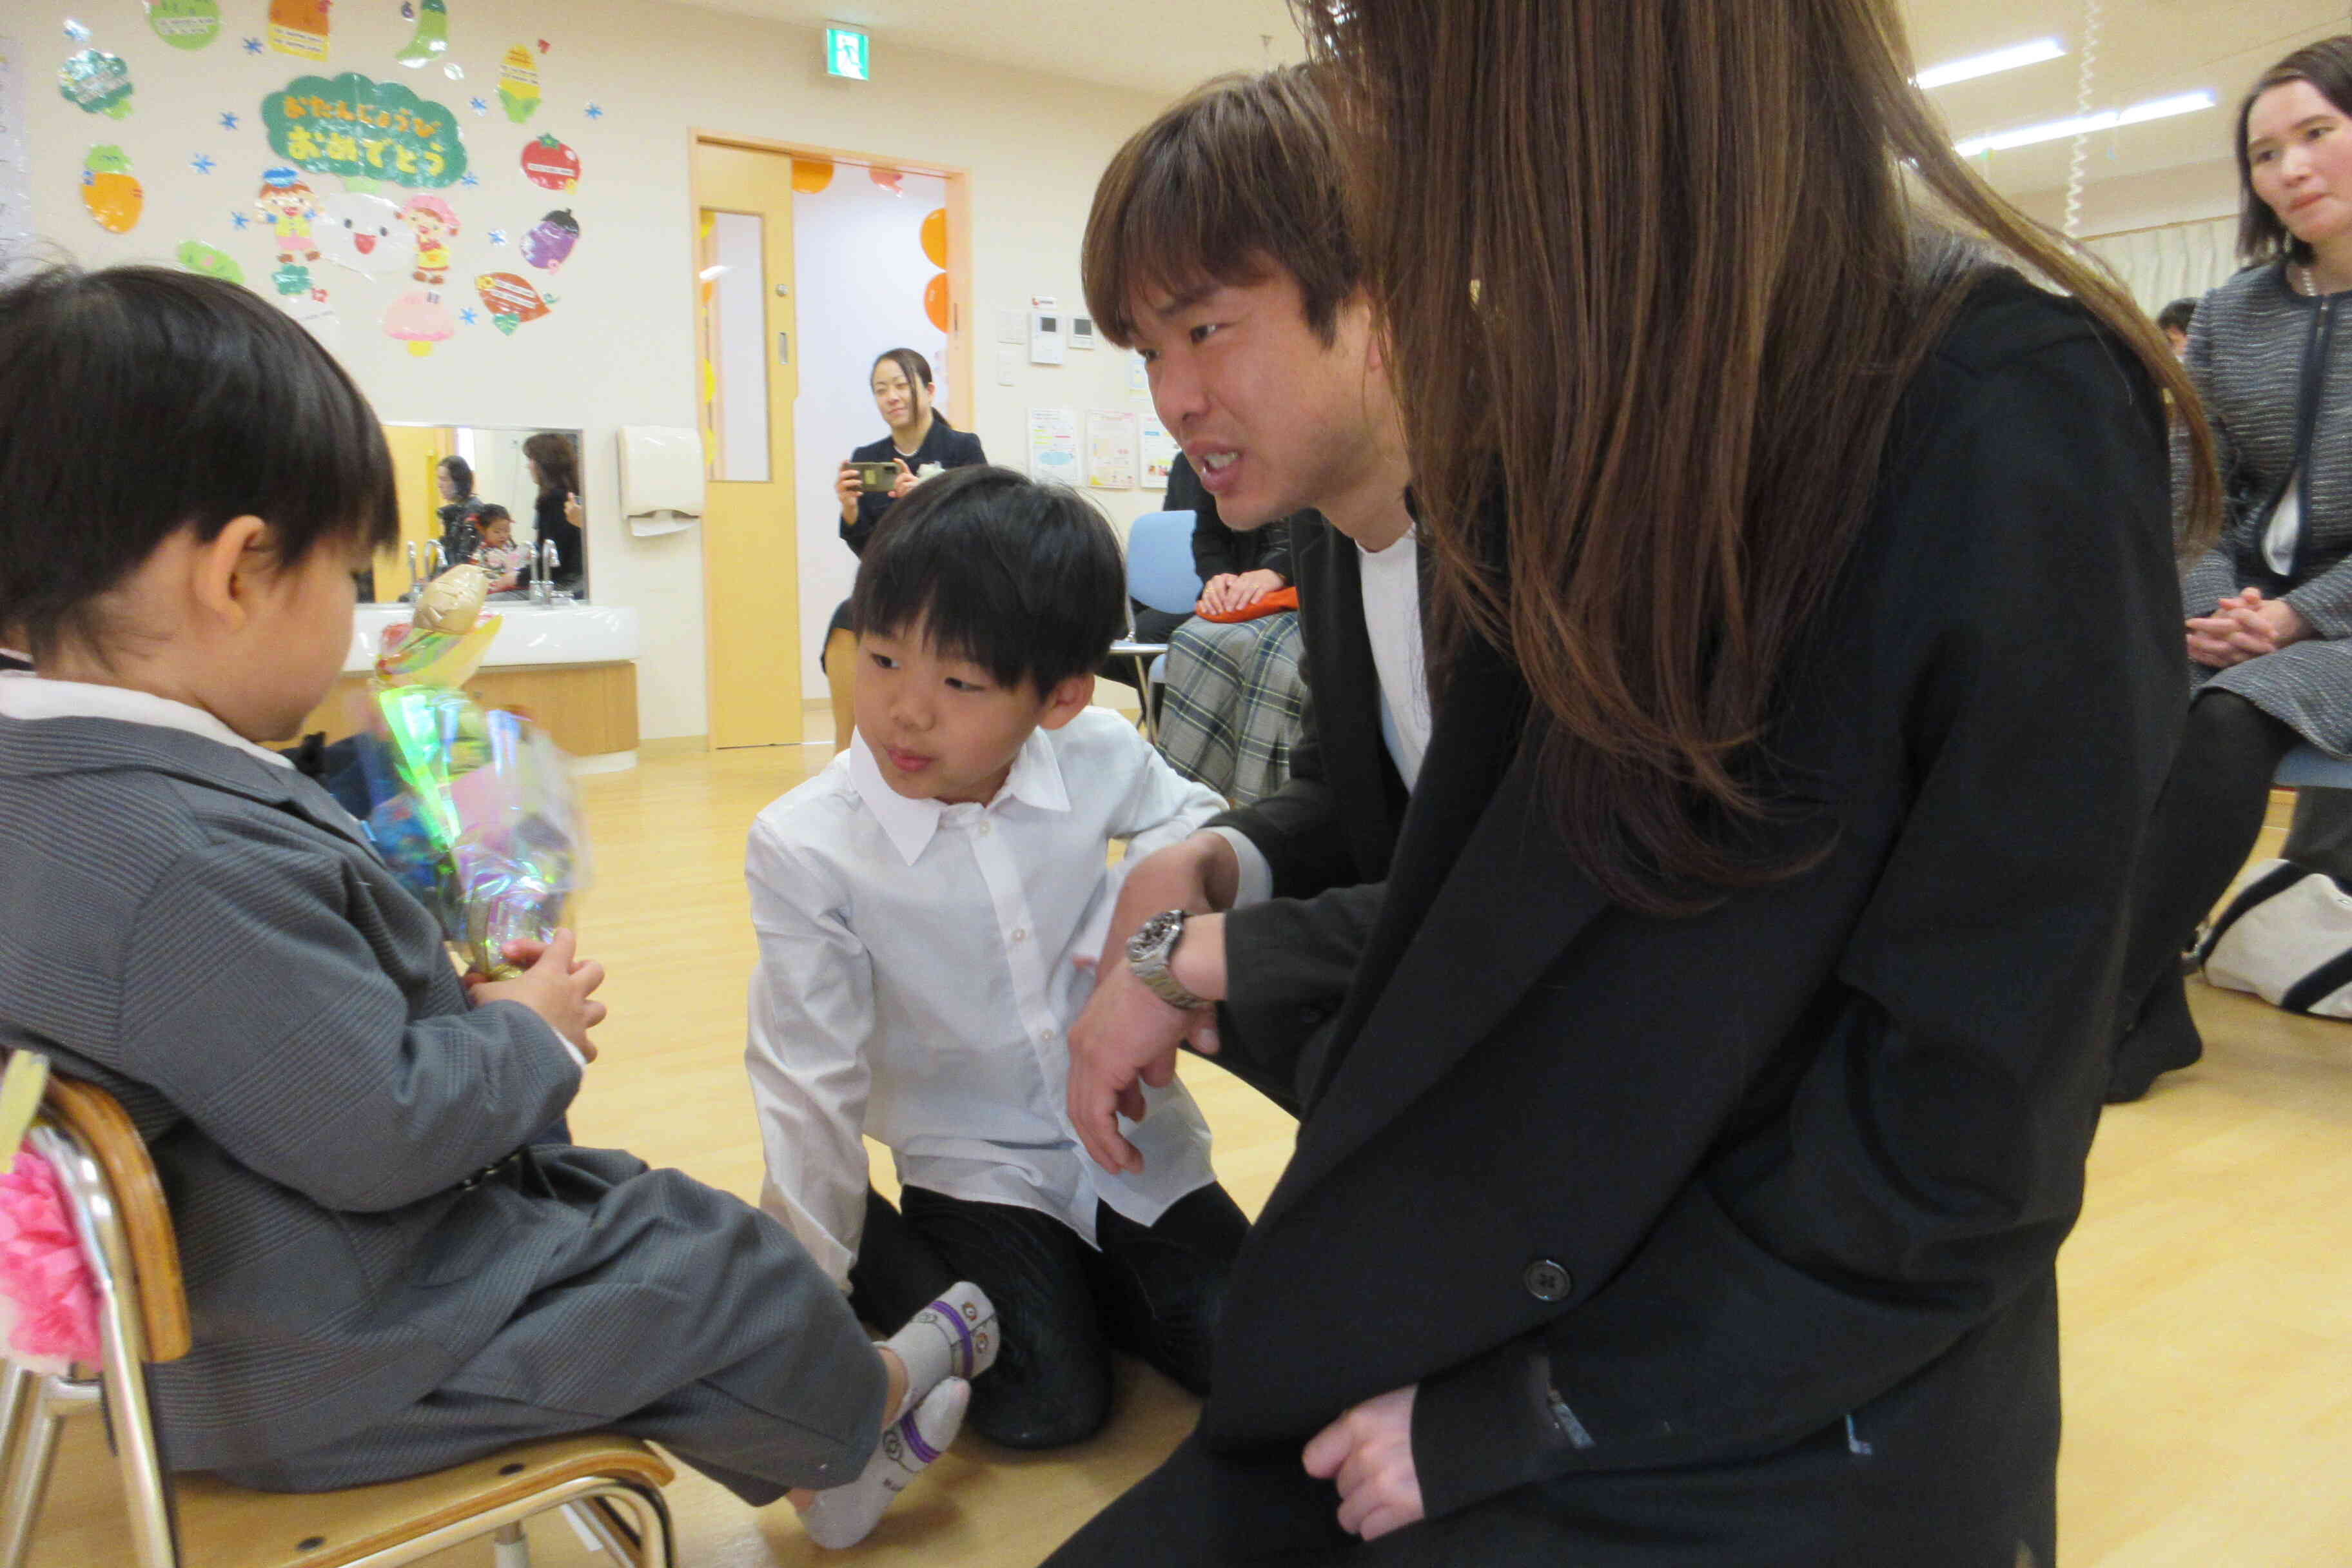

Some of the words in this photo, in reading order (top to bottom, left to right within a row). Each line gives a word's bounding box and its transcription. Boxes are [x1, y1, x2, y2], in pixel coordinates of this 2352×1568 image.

[284, 95, 443, 137] おたんじょうび
[288, 125, 446, 177] おめでとう
